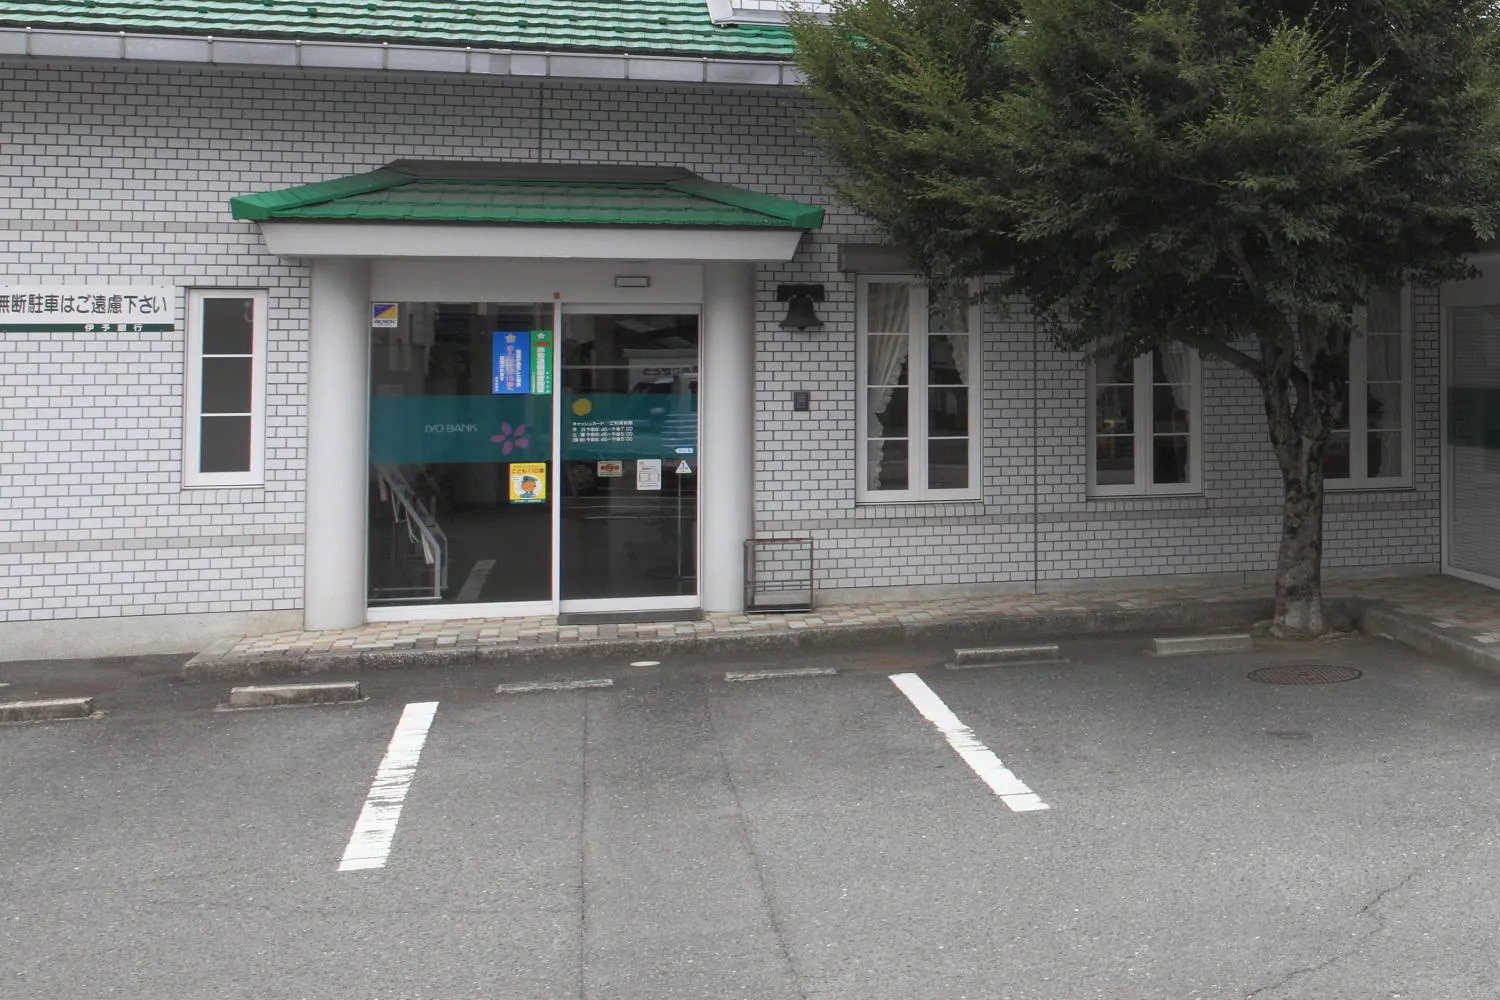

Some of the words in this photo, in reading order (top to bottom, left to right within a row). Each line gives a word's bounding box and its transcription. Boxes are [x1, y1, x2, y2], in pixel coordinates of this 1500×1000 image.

[0, 294, 167, 314] 無断駐車はご遠慮下さい
[84, 324, 143, 332] 伊予銀行
[425, 424, 444, 433] IYO
[446, 423, 478, 433] BANK
